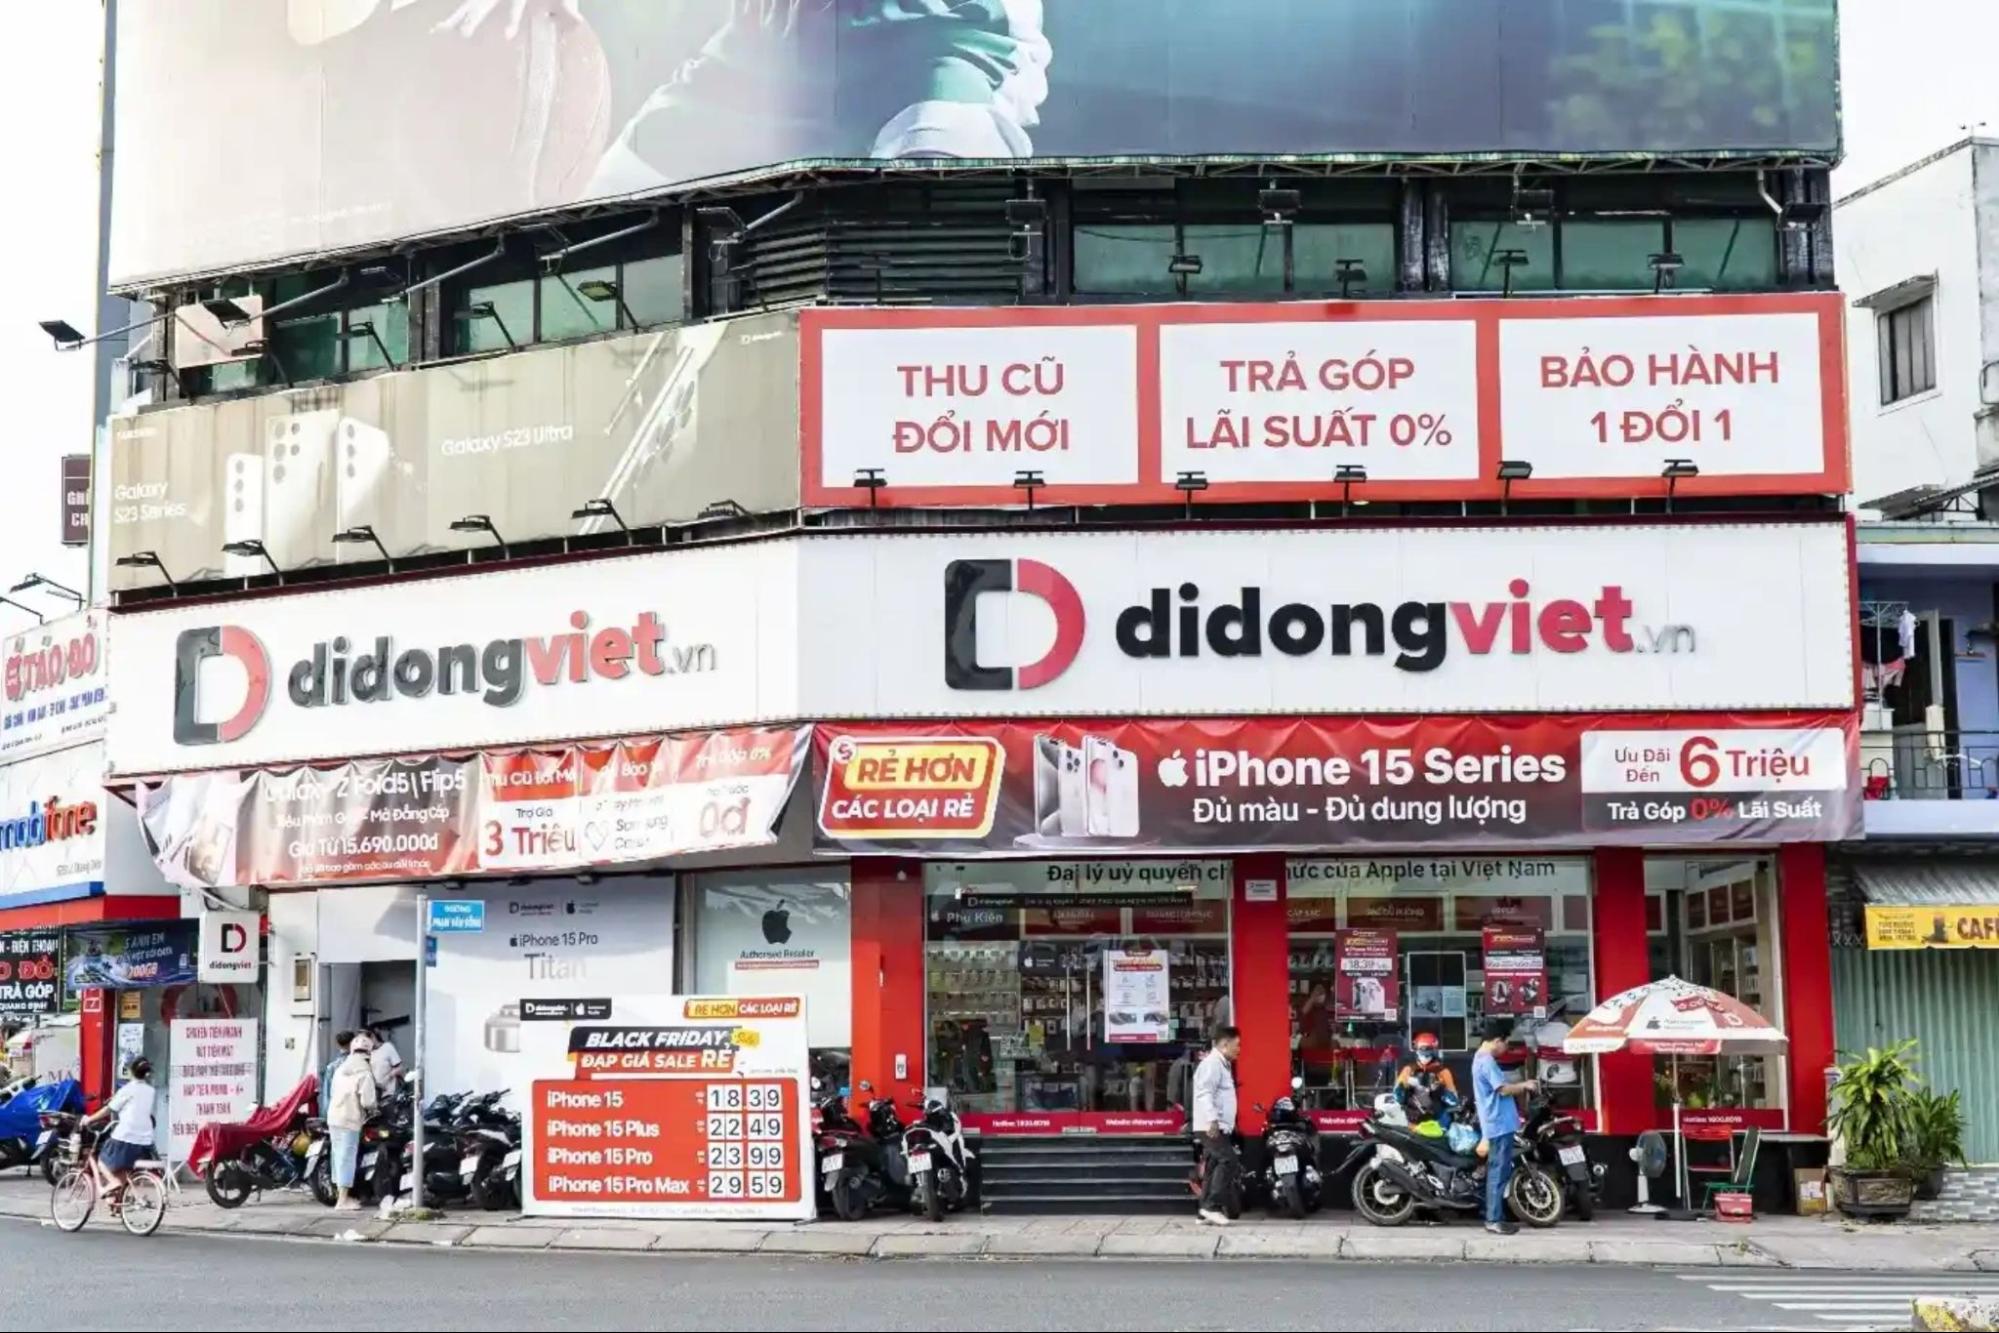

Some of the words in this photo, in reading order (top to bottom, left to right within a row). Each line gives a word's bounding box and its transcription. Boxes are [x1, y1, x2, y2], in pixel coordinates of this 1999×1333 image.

[897, 365, 988, 397] THU
[1001, 356, 1064, 397] CŨ
[1220, 350, 1307, 393] TRẢ
[1319, 348, 1415, 392] GÓP
[1541, 347, 1634, 388] BẢO
[1648, 344, 1779, 386] HÀNH
[892, 409, 971, 453] ĐỔI
[987, 409, 1069, 452] MỚI
[1186, 408, 1251, 450] LÃI
[1263, 407, 1376, 449] SUẤT
[1389, 412, 1452, 449] 0%
[1590, 411, 1607, 445] 1
[1620, 398, 1700, 444] ĐỔI
[1714, 409, 1732, 442] 1
[442, 434, 500, 457] Galaxy
[503, 429, 531, 449] S23
[534, 424, 573, 444] Ultra
[67, 490, 89, 505] GH
[114, 482, 168, 501] Galaxy
[140, 500, 187, 521] Series
[1115, 578, 1697, 672] didongviet.vn
[288, 610, 718, 708] didongviet.vn
[858, 747, 898, 783] RẺ
[904, 752, 975, 783] HƠN
[1196, 748, 1351, 788] iPhone
[1361, 749, 1414, 786] 15
[1424, 745, 1567, 784] Series
[1614, 747, 1638, 763] Ưu
[1643, 747, 1671, 763] Đãi
[1680, 735, 1721, 788] 6
[1725, 747, 1810, 784] Triệu
[421, 768, 466, 798] Flip5
[1625, 765, 1660, 783] Đến
[832, 790, 878, 819] CÁC
[884, 798, 937, 823] LOẠI
[943, 793, 975, 819] RẺ
[1193, 793, 1231, 823] Đủ
[1239, 796, 1299, 822] màu
[1325, 793, 1365, 822] Đủ
[1371, 797, 1443, 824] dung
[1448, 794, 1526, 825] lượng
[1607, 801, 1641, 820] Trả
[1644, 801, 1686, 824] Góp
[1690, 798, 1735, 820] 0%
[1738, 801, 1769, 819] Lãi
[1774, 796, 1823, 818] Suất
[484, 819, 504, 857] 3
[1047, 862, 1080, 886] Đại
[1086, 863, 1104, 885] lý
[1139, 862, 1203, 885] quyền
[1324, 860, 1361, 880] của
[1367, 861, 1425, 884] Apple
[1431, 860, 1456, 882] tại
[1462, 858, 1502, 882] Việt
[1508, 858, 1556, 879] Nam
[519, 933, 560, 947] iPhone
[561, 932, 577, 946] 15
[578, 931, 599, 945] Pro
[209, 960, 252, 971] didongviet
[524, 952, 588, 980] Titan
[586, 1032, 650, 1048] BLACK
[581, 1053, 618, 1072] ĐẠP
[622, 1051, 650, 1068] GIÁ
[655, 1053, 696, 1068] SALE
[701, 1042, 733, 1068] RẺ
[547, 1090, 601, 1108] iPhone
[604, 1090, 623, 1108] 15
[547, 1119, 601, 1138] iPhone
[604, 1120, 621, 1137] 15
[626, 1120, 660, 1138] Plus
[547, 1149, 601, 1166] iPhone
[604, 1149, 622, 1166] 15
[626, 1149, 653, 1166] Pro
[549, 1176, 602, 1194] iPhone
[604, 1176, 622, 1193] 15
[626, 1177, 653, 1194] Pro
[655, 1177, 690, 1195] Max
